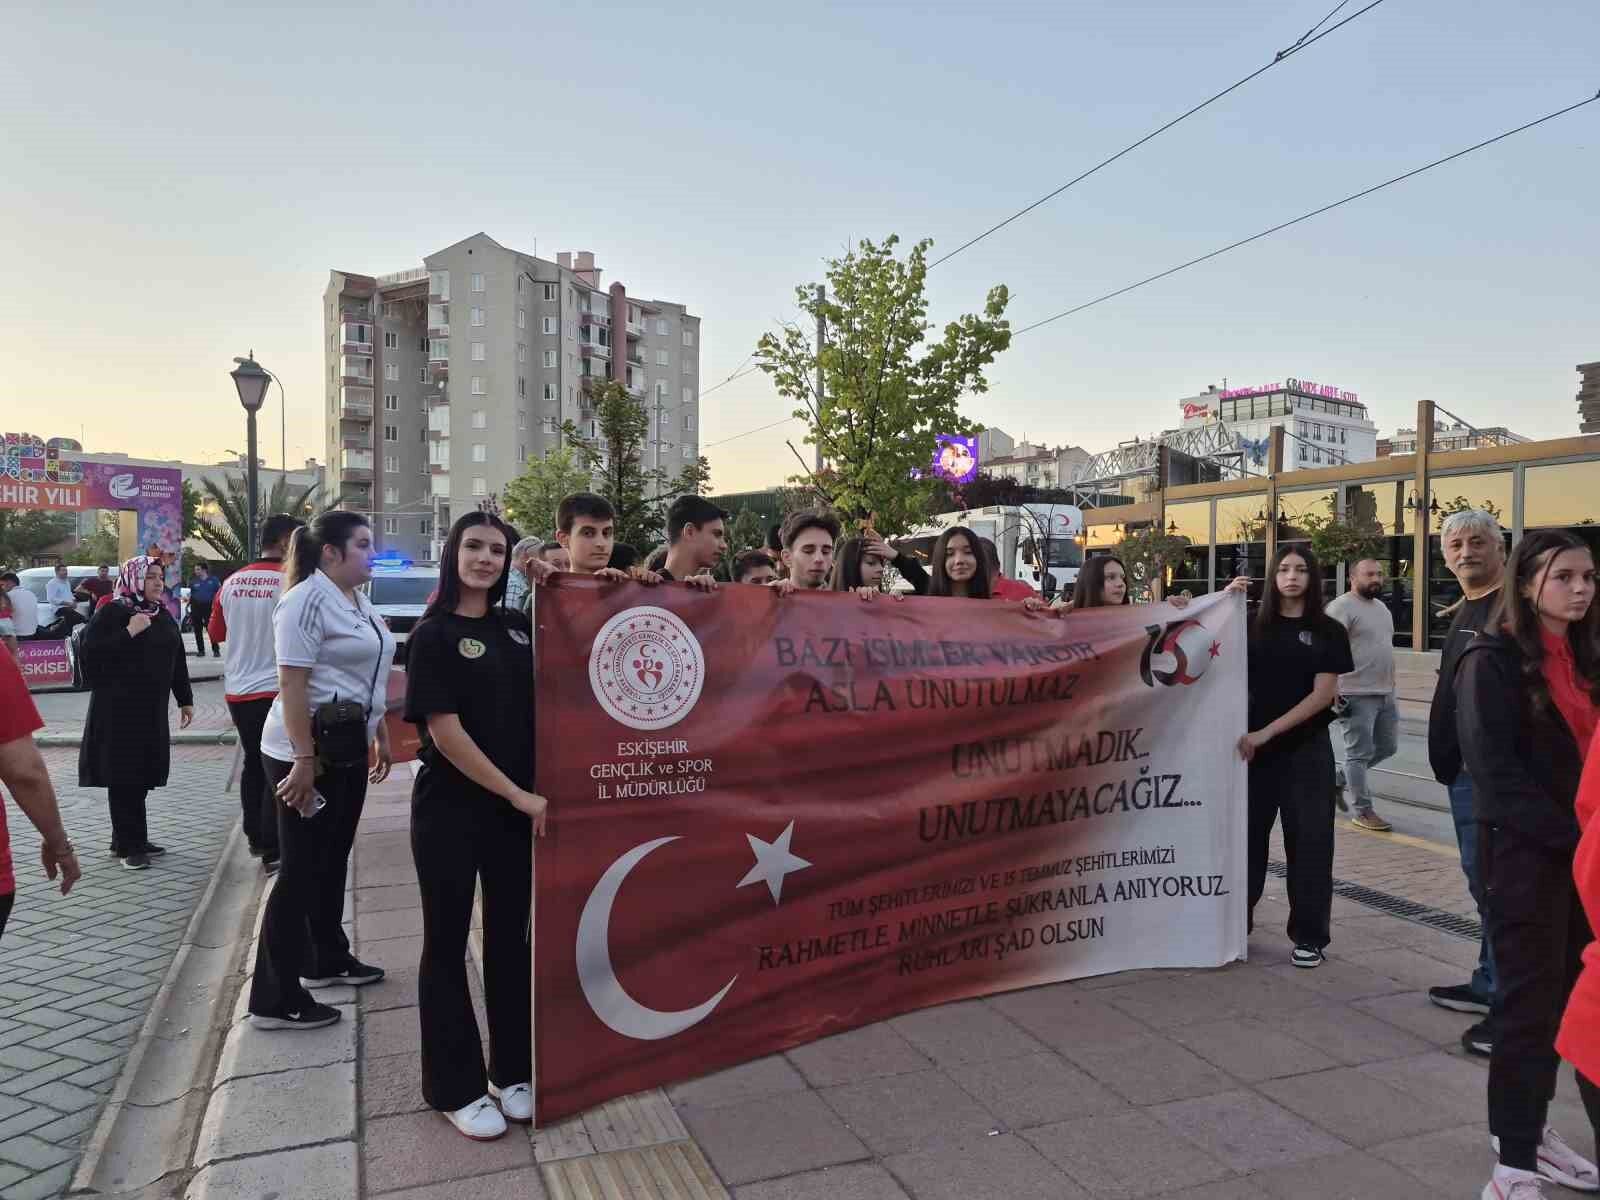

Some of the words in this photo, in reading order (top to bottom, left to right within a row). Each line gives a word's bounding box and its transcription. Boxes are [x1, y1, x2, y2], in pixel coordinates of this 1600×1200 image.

[45, 487, 81, 506] YILI
[774, 637, 855, 667] BAZI
[805, 679, 897, 713] ASLA
[905, 673, 1081, 709] UNUTULMAZ
[617, 738, 689, 758] ESKİŞEHİR
[590, 759, 655, 780] GENÇLİK
[658, 763, 674, 775] ve
[677, 759, 713, 774] SPOR
[598, 782, 611, 799] İL
[616, 775, 706, 798] MÜDÜRLÜĞÜ
[919, 765, 1203, 843] UNUTMAYACAĞIZ...
[979, 872, 1000, 889] VE
[1075, 845, 1176, 876] ŞEHİTLERİMİZİ
[995, 927, 1035, 961] ŞAD
[1040, 916, 1105, 946] OLSUN
